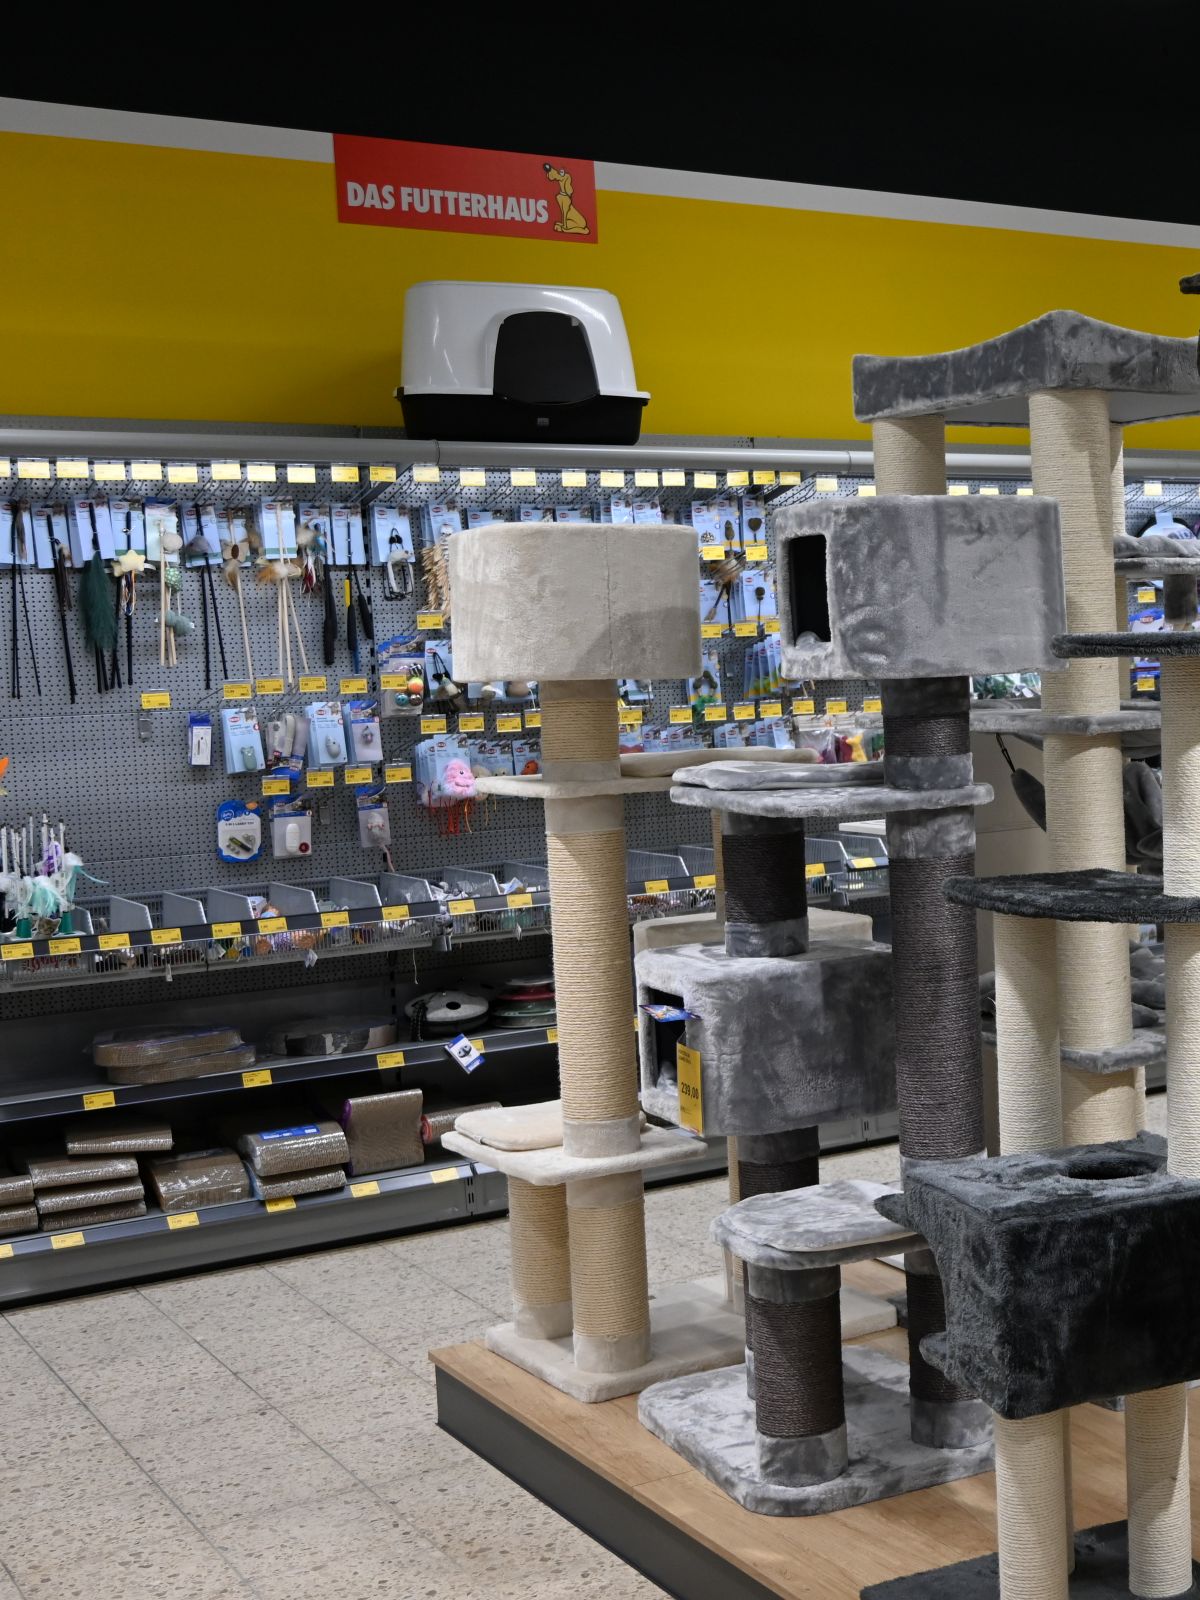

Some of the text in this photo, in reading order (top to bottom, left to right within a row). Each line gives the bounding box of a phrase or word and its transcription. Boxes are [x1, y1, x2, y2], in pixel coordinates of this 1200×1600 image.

[346, 181, 549, 224] DAS FUTTERHAUS
[681, 1082, 699, 1100] 239,00
